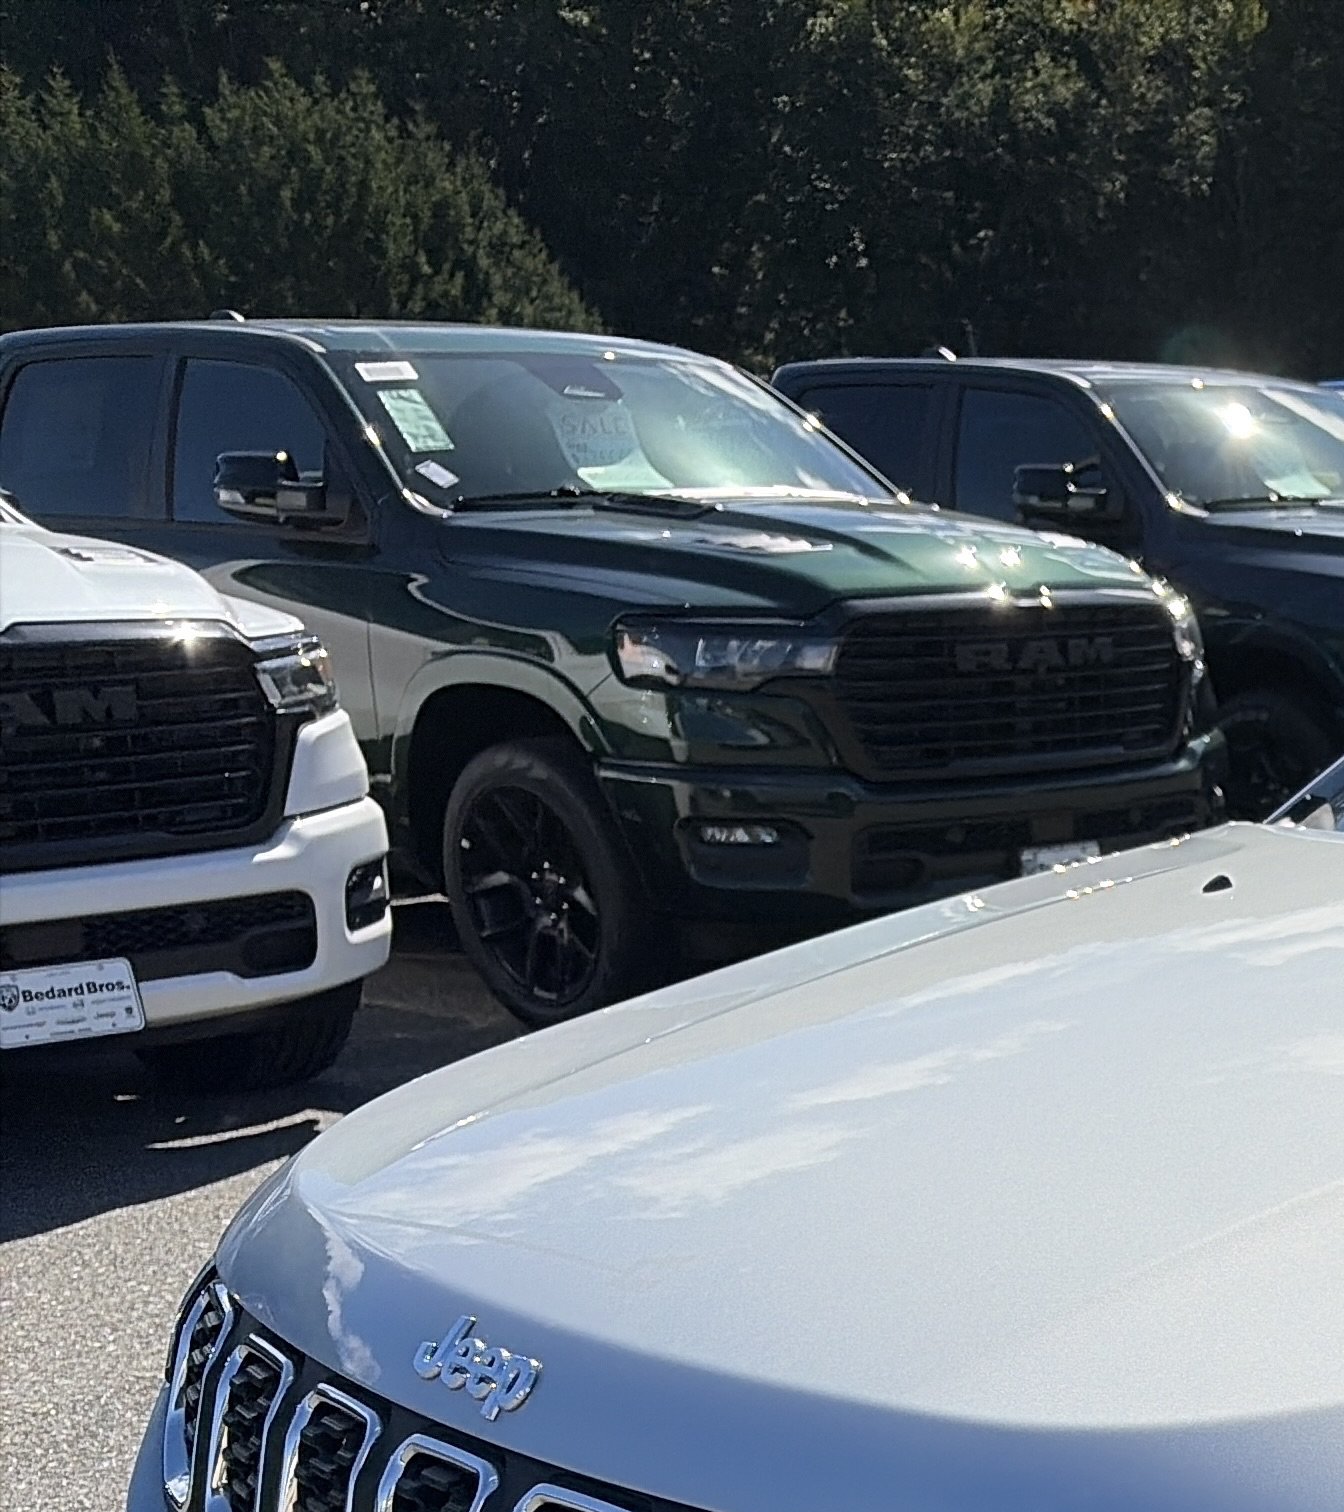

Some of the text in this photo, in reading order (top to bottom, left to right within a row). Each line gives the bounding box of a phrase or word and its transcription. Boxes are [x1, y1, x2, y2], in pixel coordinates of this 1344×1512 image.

[956, 637, 1113, 671] RAM
[21, 980, 131, 1003] Bedard Bros.
[413, 1314, 543, 1421] Jeep
